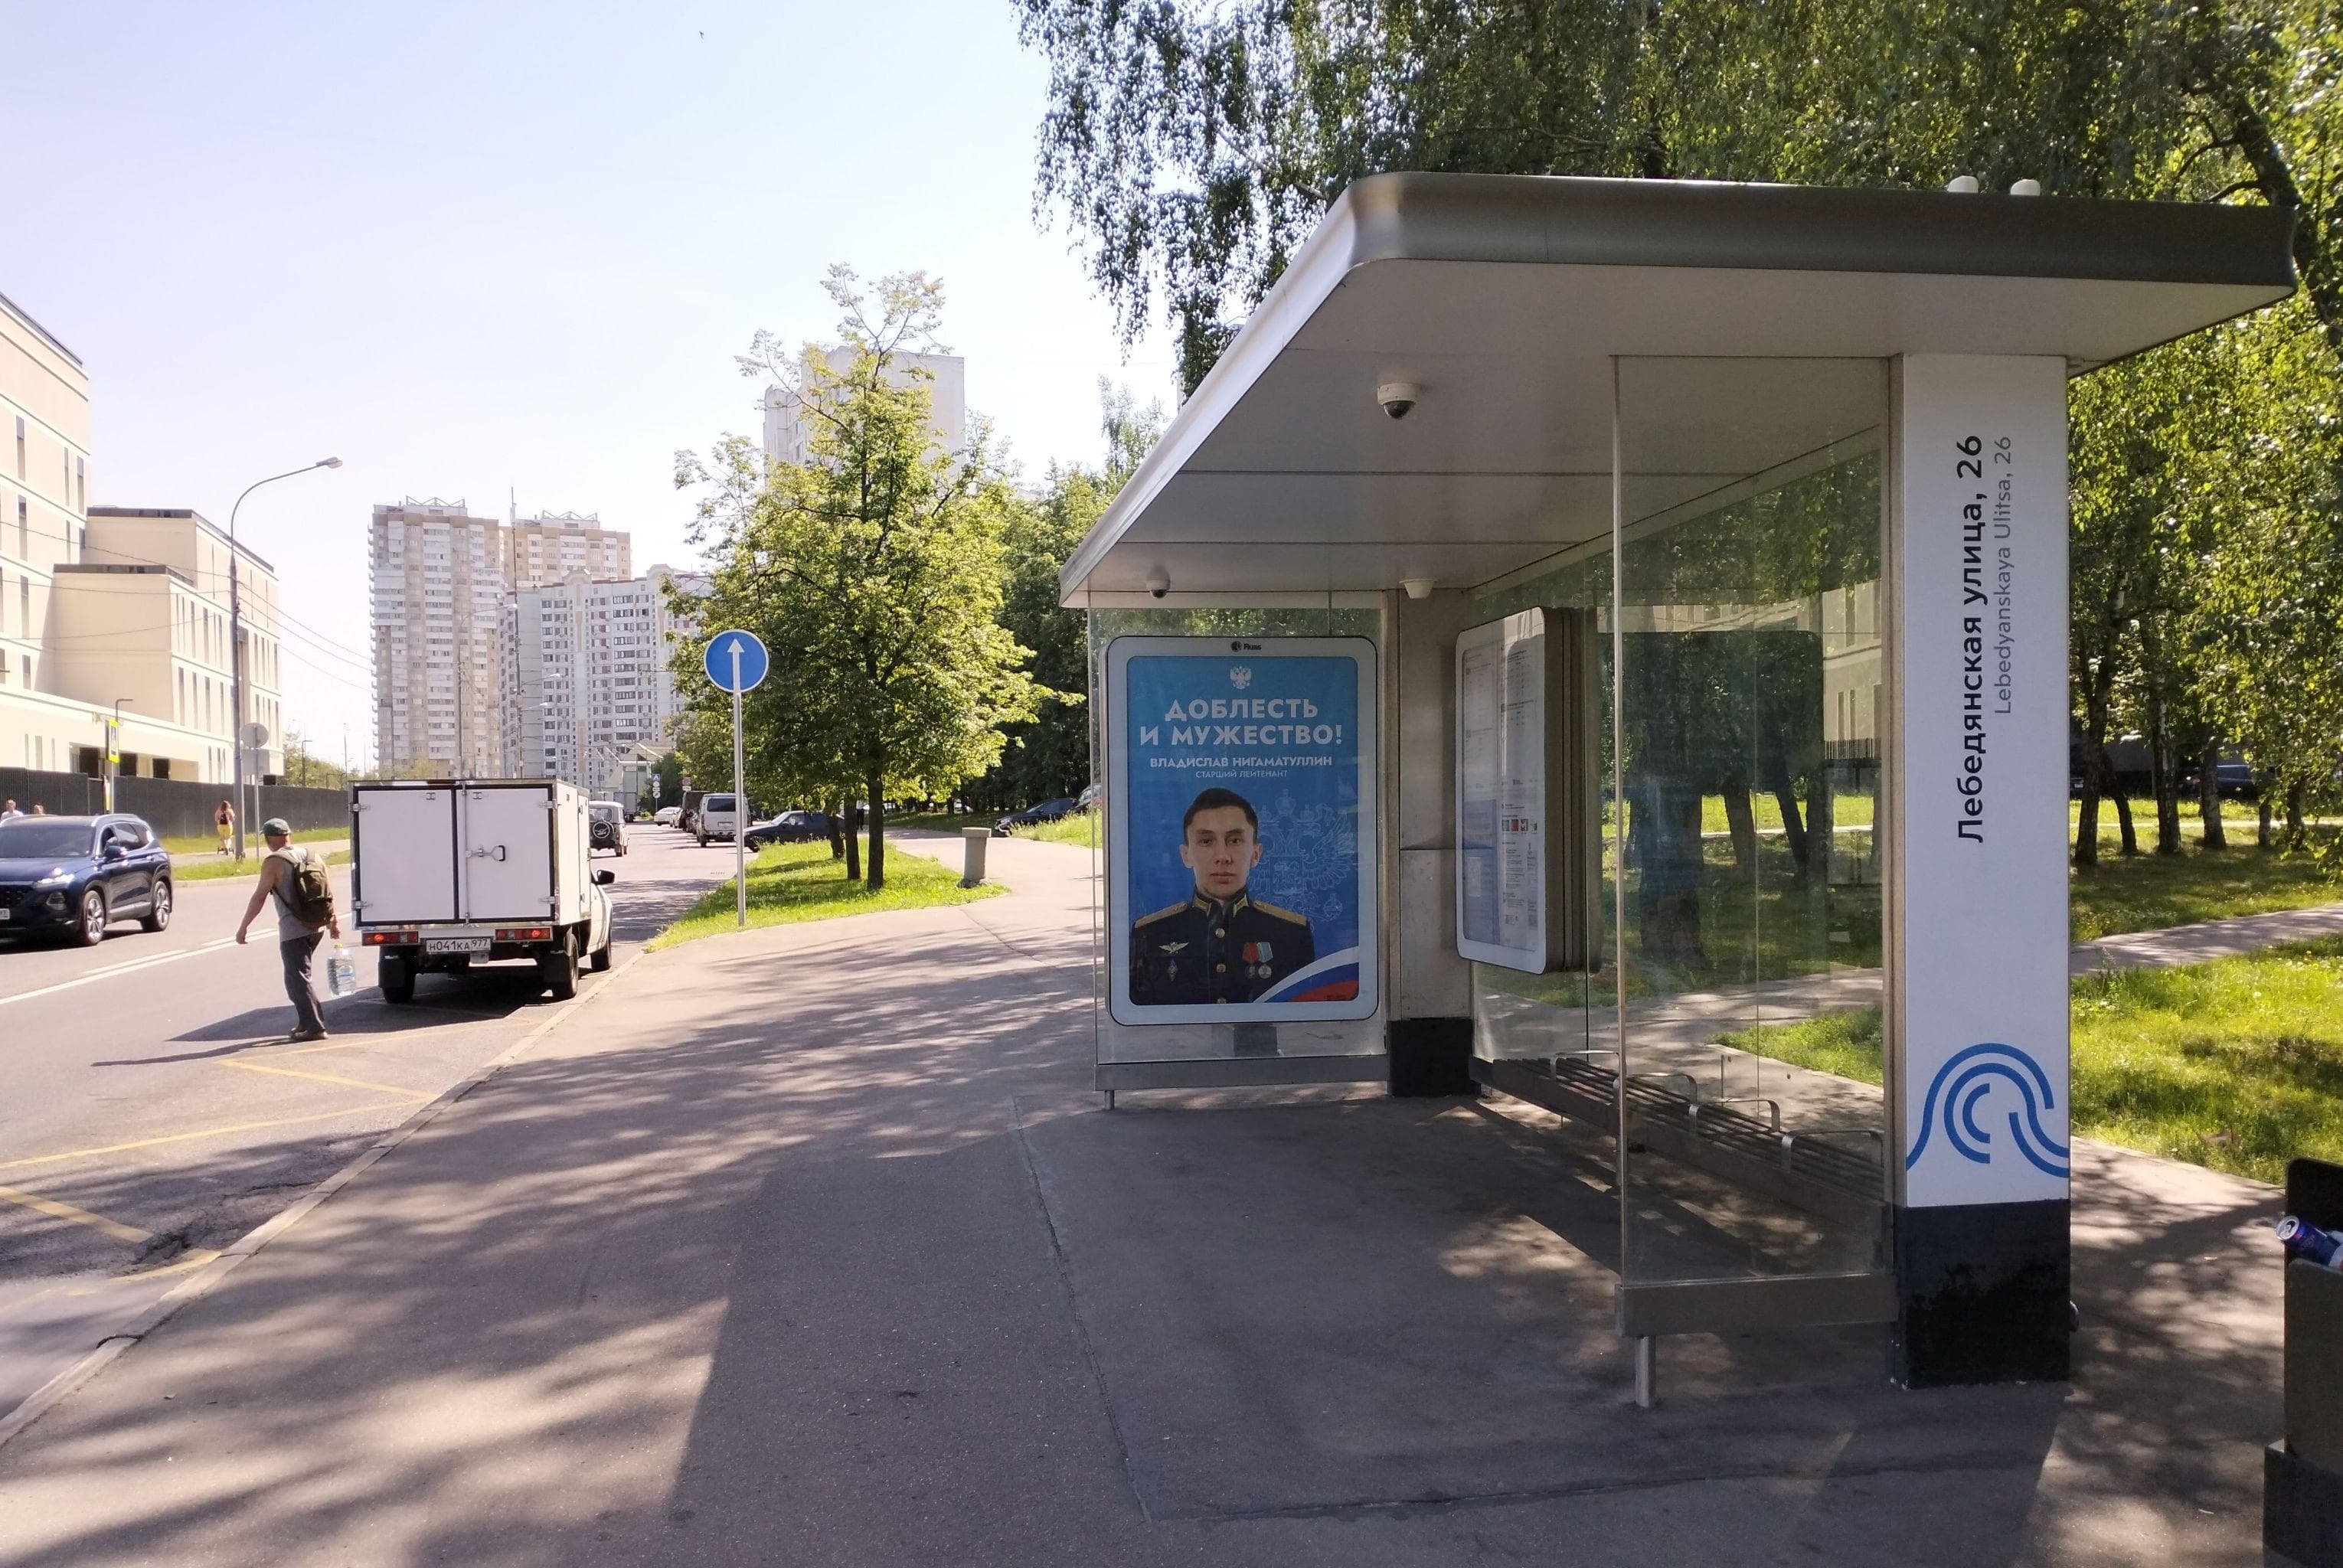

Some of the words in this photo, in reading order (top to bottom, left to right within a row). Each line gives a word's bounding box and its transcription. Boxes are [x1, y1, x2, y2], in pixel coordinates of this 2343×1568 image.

[1956, 435, 1982, 479] 26
[1994, 436, 2011, 466] 26
[1994, 472, 2012, 539] Ulitsa,
[1963, 492, 1988, 606] улица,
[1994, 547, 2015, 714] Lebedyanskaya
[1165, 698, 1318, 721] ДОБЛЕСТЬ
[1140, 726, 1158, 746] И
[1172, 724, 1342, 746] МУЖЕСТВО!
[1956, 616, 1986, 844] Лебедянская
[1150, 757, 1229, 769] ВЛАДИСЛАВ
[1233, 756, 1332, 767] НИГАМАТУЛЛИН
[1195, 769, 1237, 779] СТАРШИЙ
